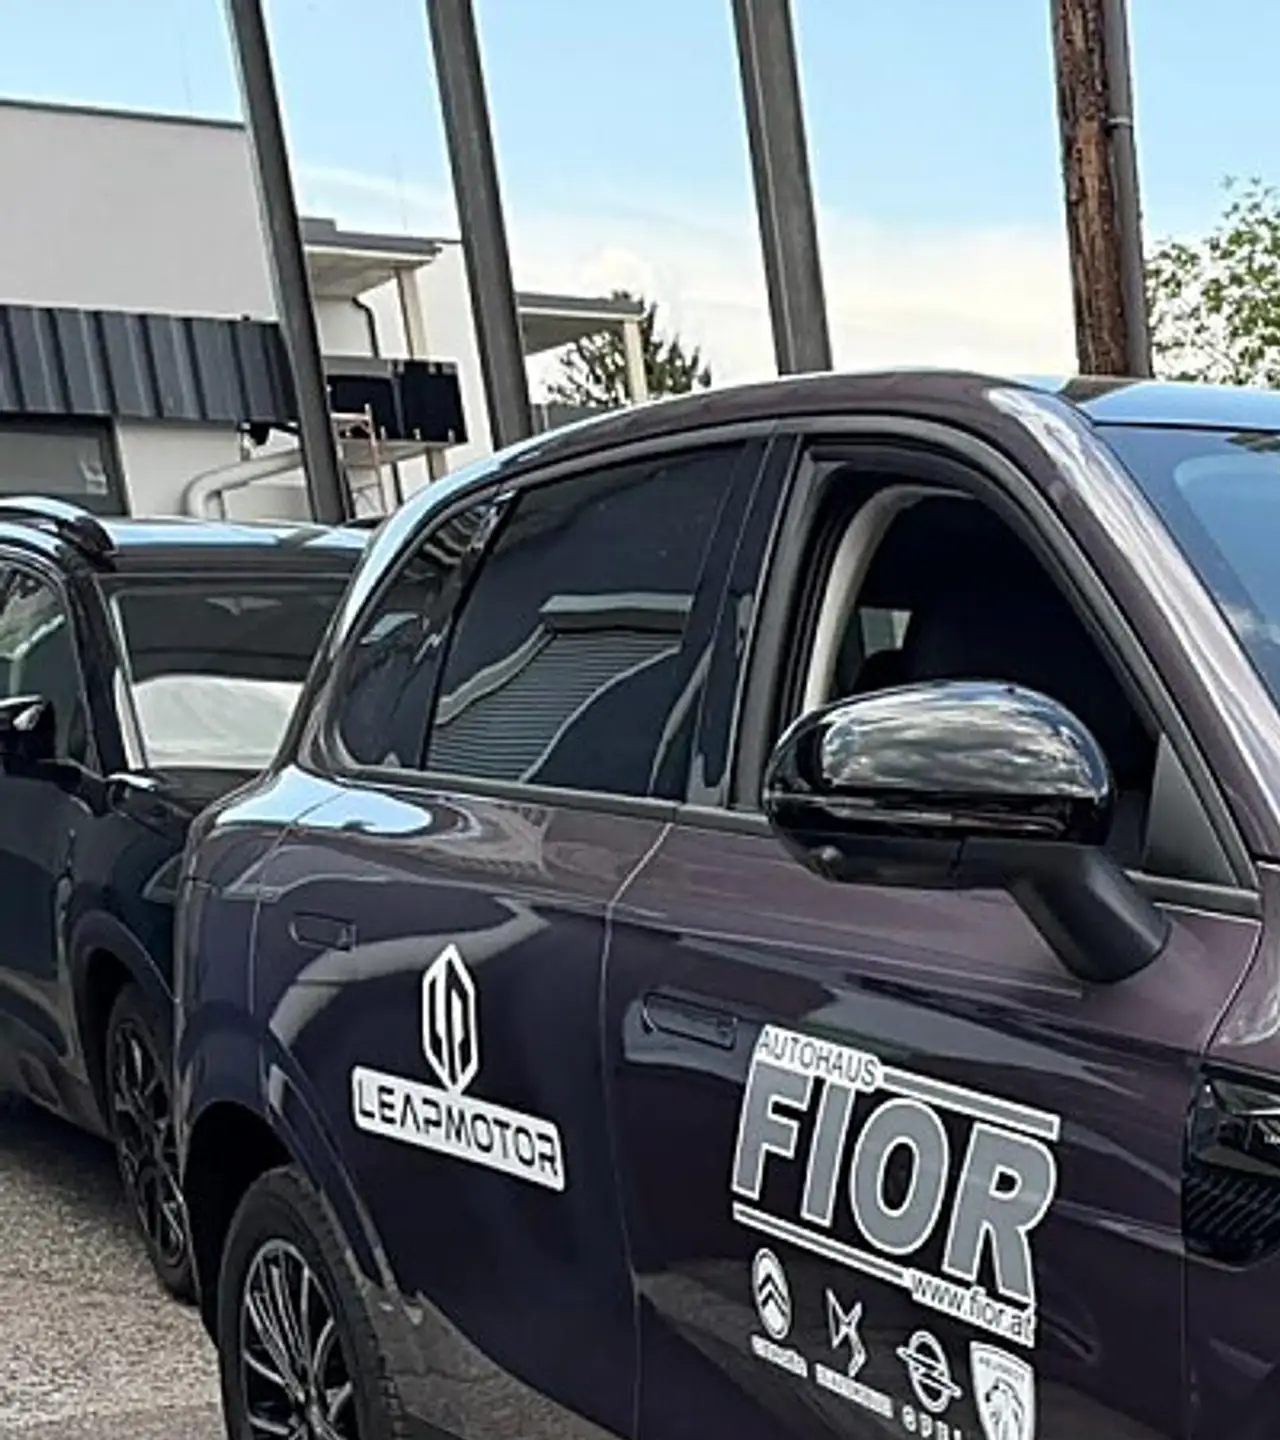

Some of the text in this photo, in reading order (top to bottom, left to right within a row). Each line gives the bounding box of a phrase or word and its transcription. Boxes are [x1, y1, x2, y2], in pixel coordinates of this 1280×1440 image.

[757, 1029, 879, 1088] AUTOHAUS
[357, 1077, 559, 1178] LEAPMOTOR
[731, 1057, 1058, 1304] FIOR
[911, 1272, 1034, 1343] www.fior.at
